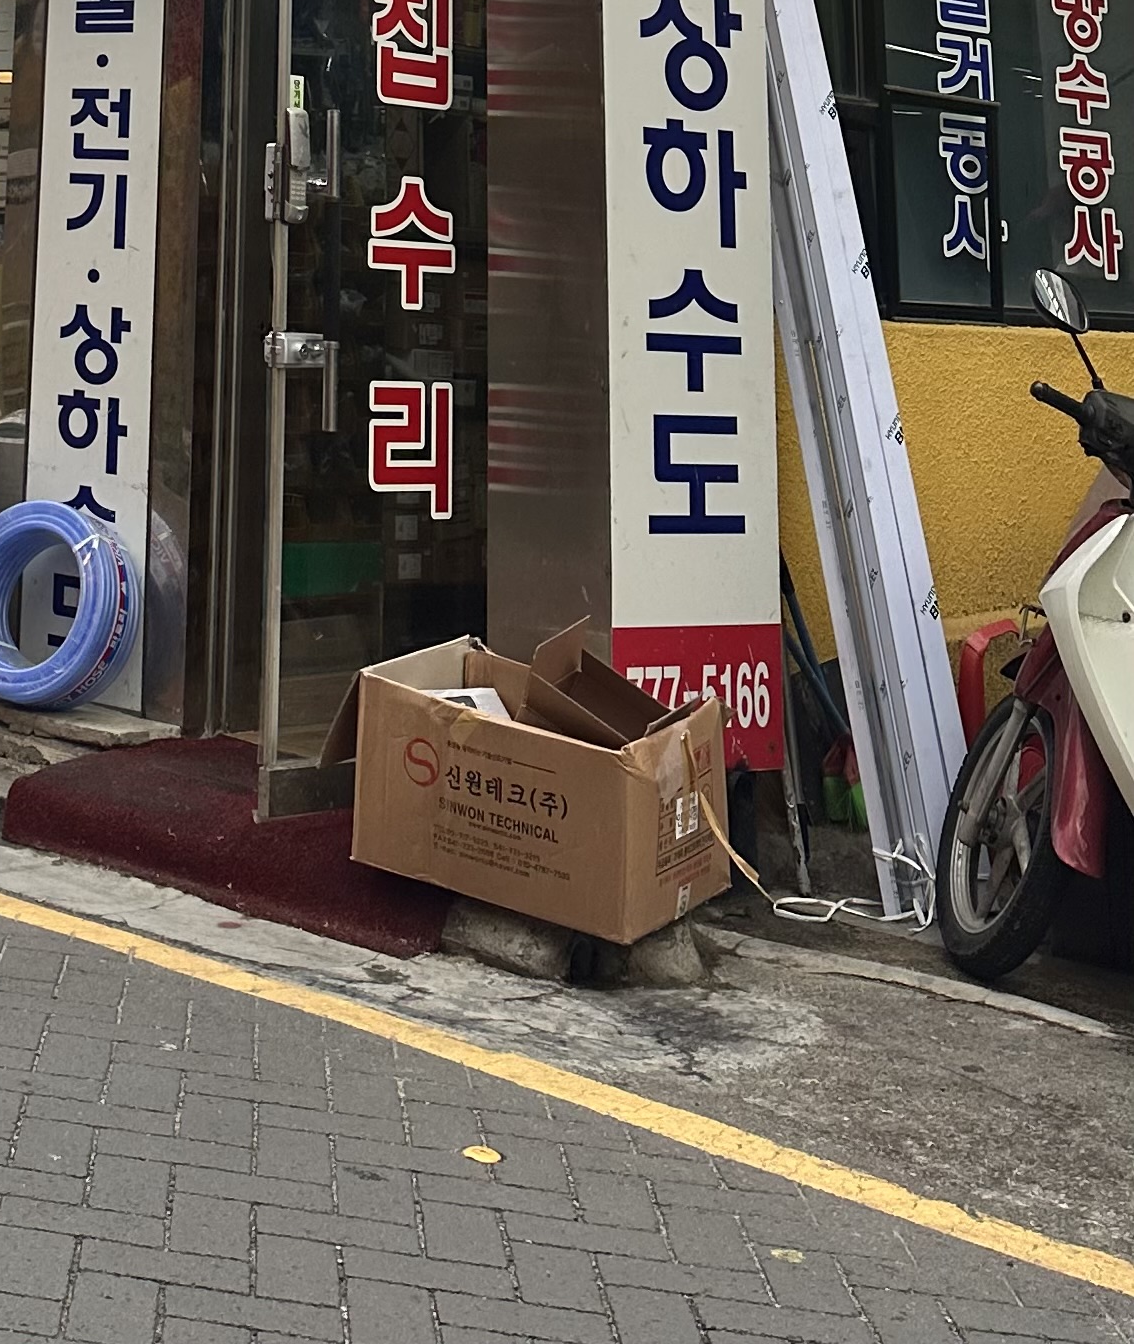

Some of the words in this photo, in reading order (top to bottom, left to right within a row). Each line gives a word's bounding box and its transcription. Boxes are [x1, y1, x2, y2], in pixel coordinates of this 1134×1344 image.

[445, 765, 568, 820] 신원테크(주)
[439, 796, 485, 824] SINWON
[489, 812, 559, 844] TECHNICAL
